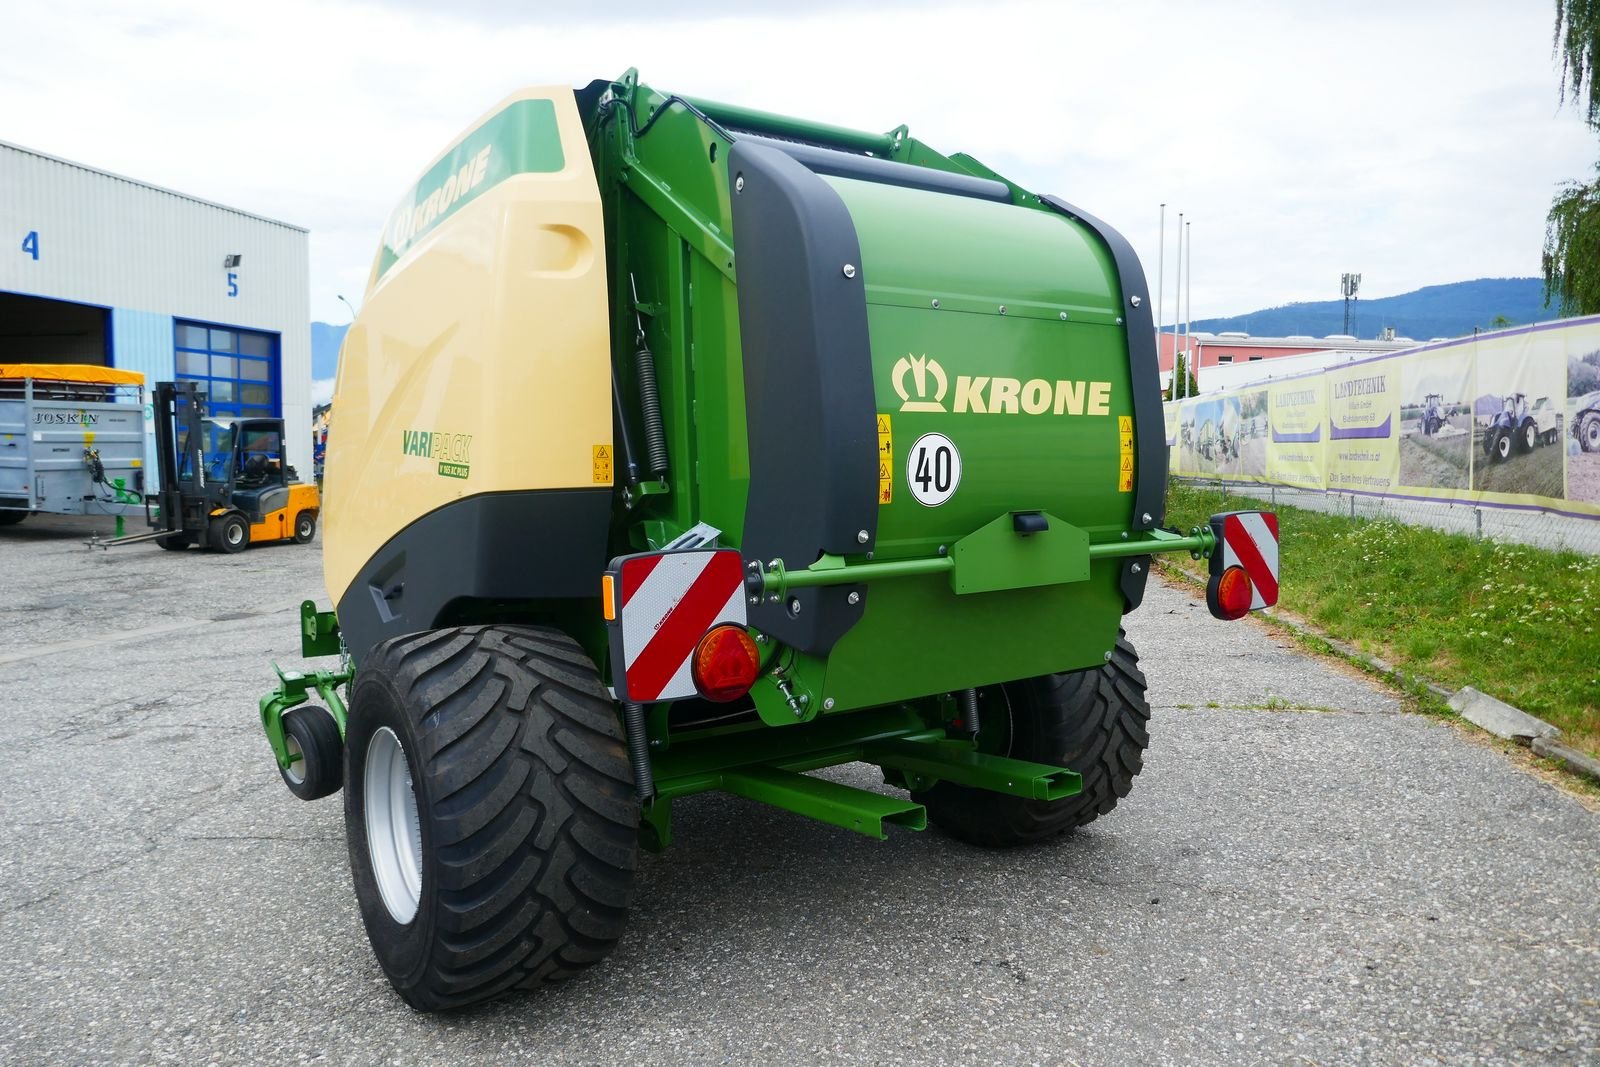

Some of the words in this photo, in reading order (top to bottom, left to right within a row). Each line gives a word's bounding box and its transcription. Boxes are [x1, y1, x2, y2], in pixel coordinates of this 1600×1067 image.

[414, 143, 492, 232] KRONE
[21, 230, 40, 261] 4
[227, 272, 239, 297] 5
[953, 375, 1112, 416] KRONE
[1334, 375, 1386, 400] LANDTECHNIK
[33, 412, 100, 425] JOSKIN
[402, 429, 473, 464] VARIPACK
[914, 445, 952, 493] 40
